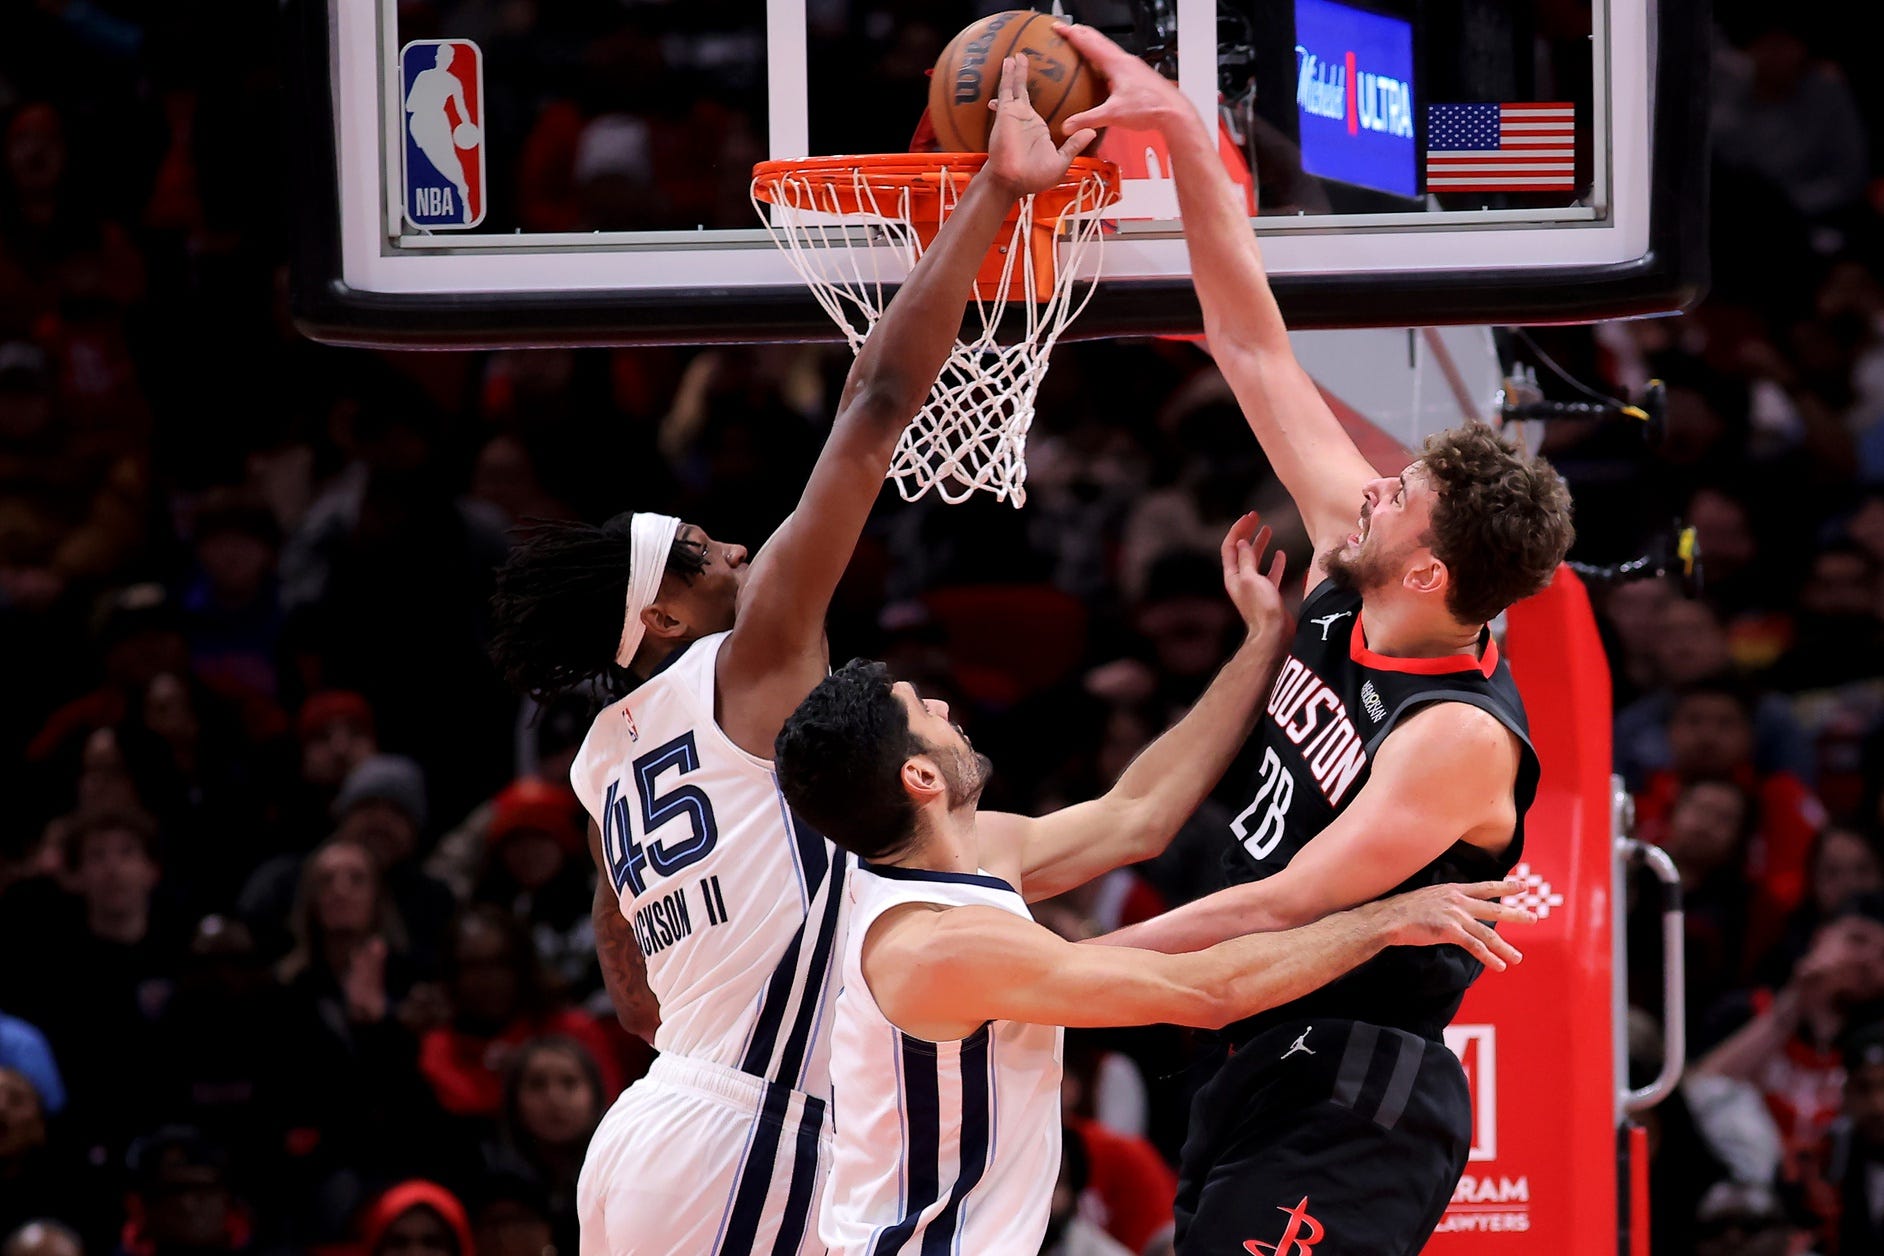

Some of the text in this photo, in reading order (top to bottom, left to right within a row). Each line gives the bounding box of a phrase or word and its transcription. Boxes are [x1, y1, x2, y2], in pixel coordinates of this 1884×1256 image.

[1356, 71, 1414, 139] ULTRA
[415, 187, 454, 216] NBA
[1266, 654, 1367, 810] OUSTON
[603, 729, 718, 899] 45
[1229, 746, 1294, 861] 28
[634, 875, 728, 957] CKSON II
[1450, 1174, 1530, 1203] RAM
